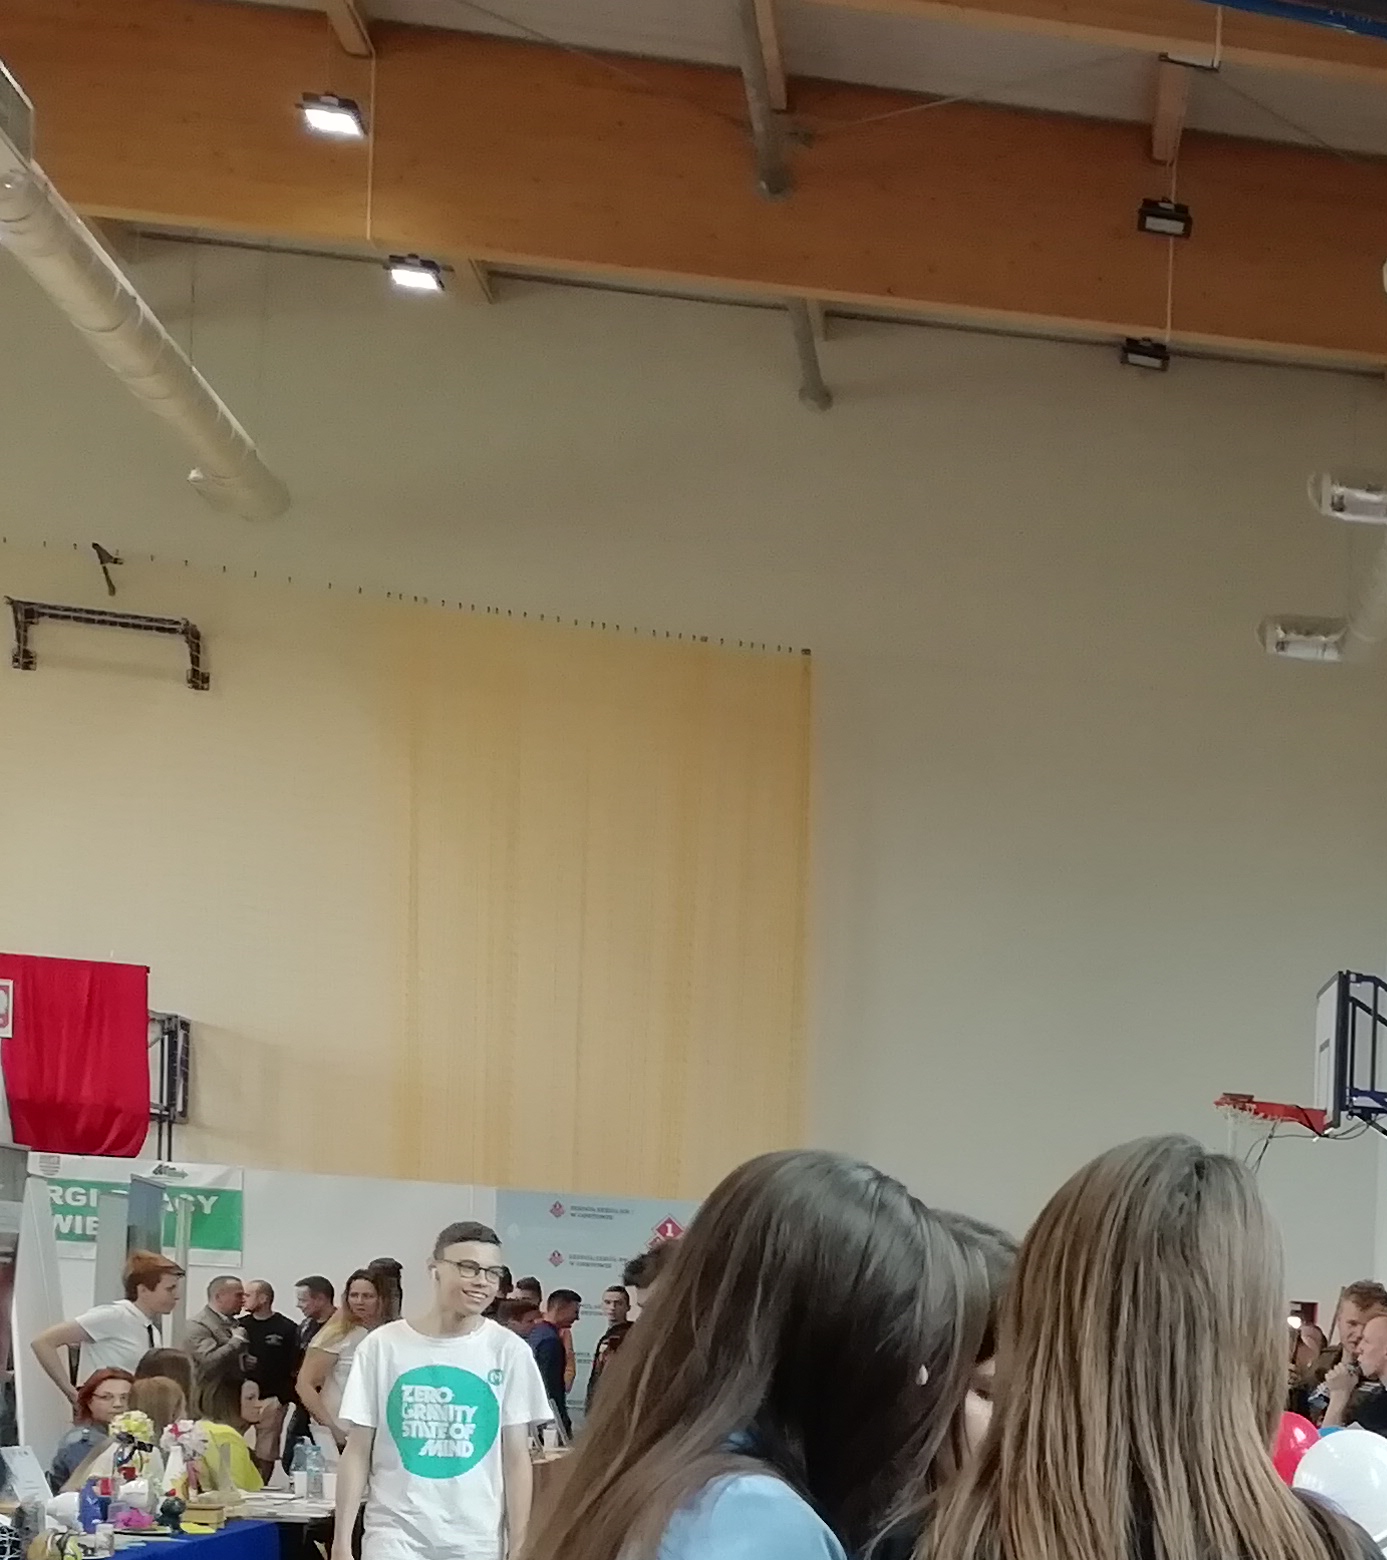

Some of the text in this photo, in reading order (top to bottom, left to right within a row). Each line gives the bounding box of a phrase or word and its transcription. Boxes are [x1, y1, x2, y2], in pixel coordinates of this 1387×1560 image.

[401, 1384, 454, 1404] ZERO
[401, 1403, 478, 1423] GRAVITY
[401, 1421, 477, 1440] STATE OF
[418, 1439, 475, 1458] MIND
